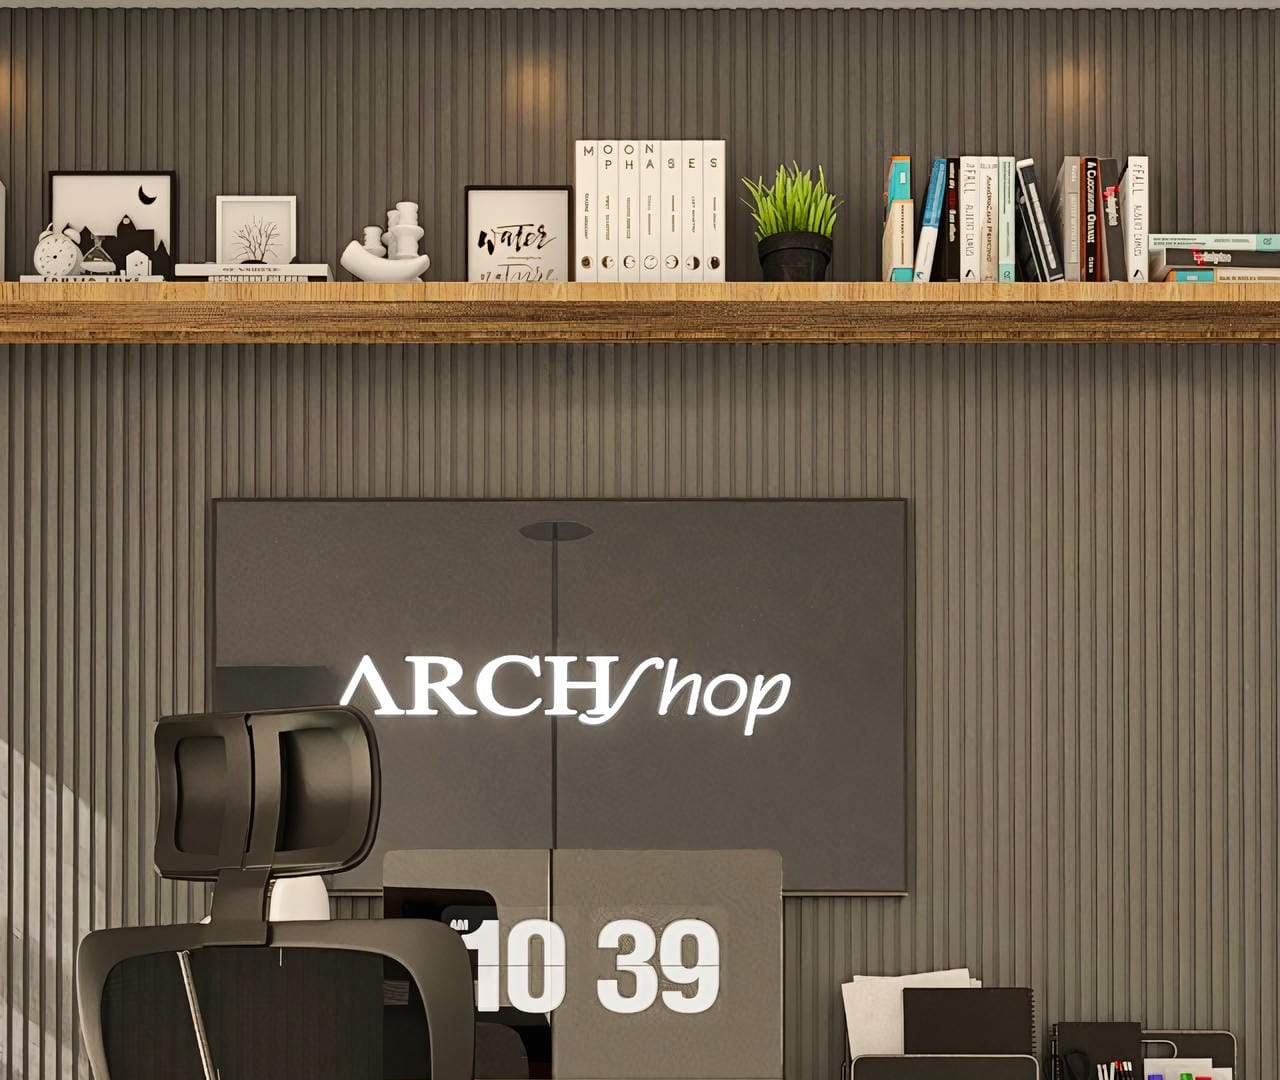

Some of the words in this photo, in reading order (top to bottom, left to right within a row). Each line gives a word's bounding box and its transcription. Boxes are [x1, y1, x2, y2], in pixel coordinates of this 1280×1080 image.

[583, 143, 654, 157] MOON
[478, 224, 557, 255] water
[460, 918, 567, 1013] 10
[596, 918, 721, 1014] 39
